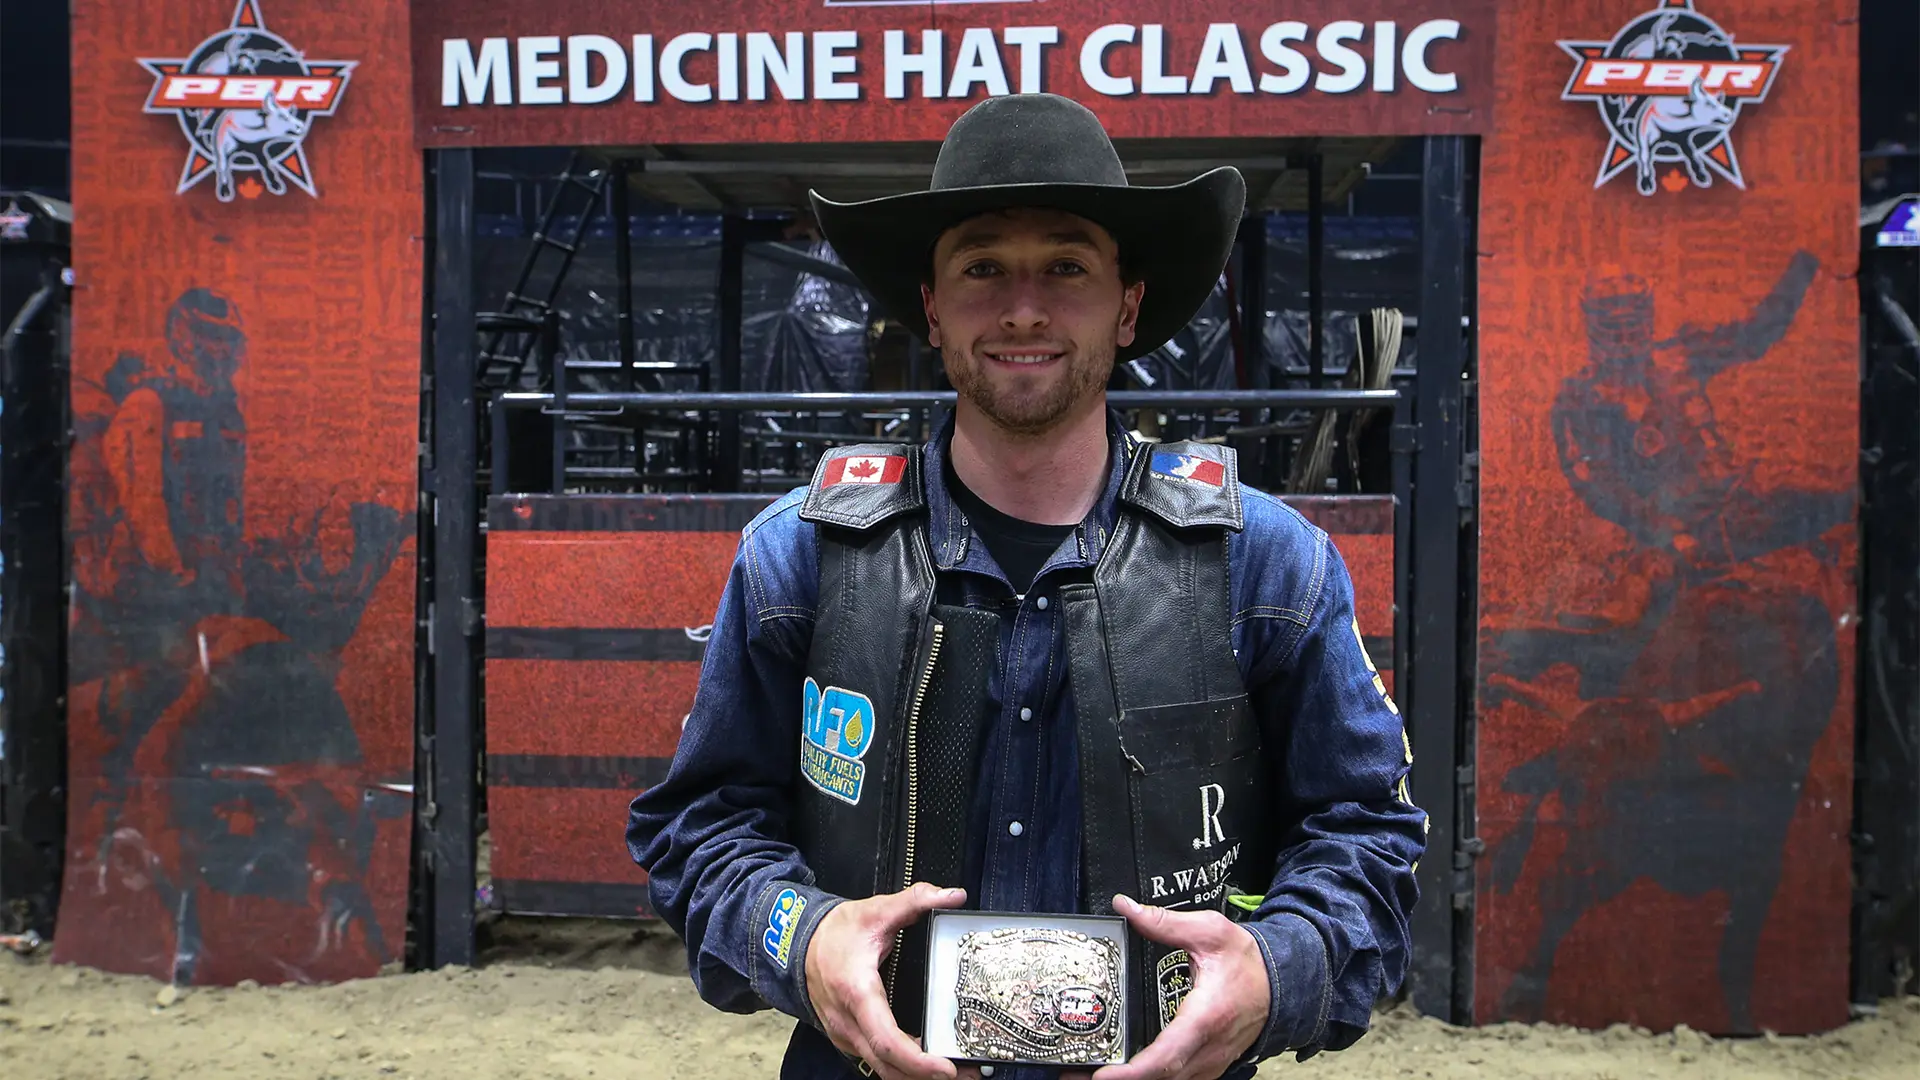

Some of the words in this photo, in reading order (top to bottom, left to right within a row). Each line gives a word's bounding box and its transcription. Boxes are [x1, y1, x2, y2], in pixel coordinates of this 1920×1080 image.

[441, 31, 860, 107] MEDICINE
[883, 25, 1059, 99] HAT
[1079, 18, 1461, 96] CLASSIC
[1584, 61, 1763, 89] PBR
[163, 77, 334, 103] PBR
[829, 755, 861, 781] FUELS
